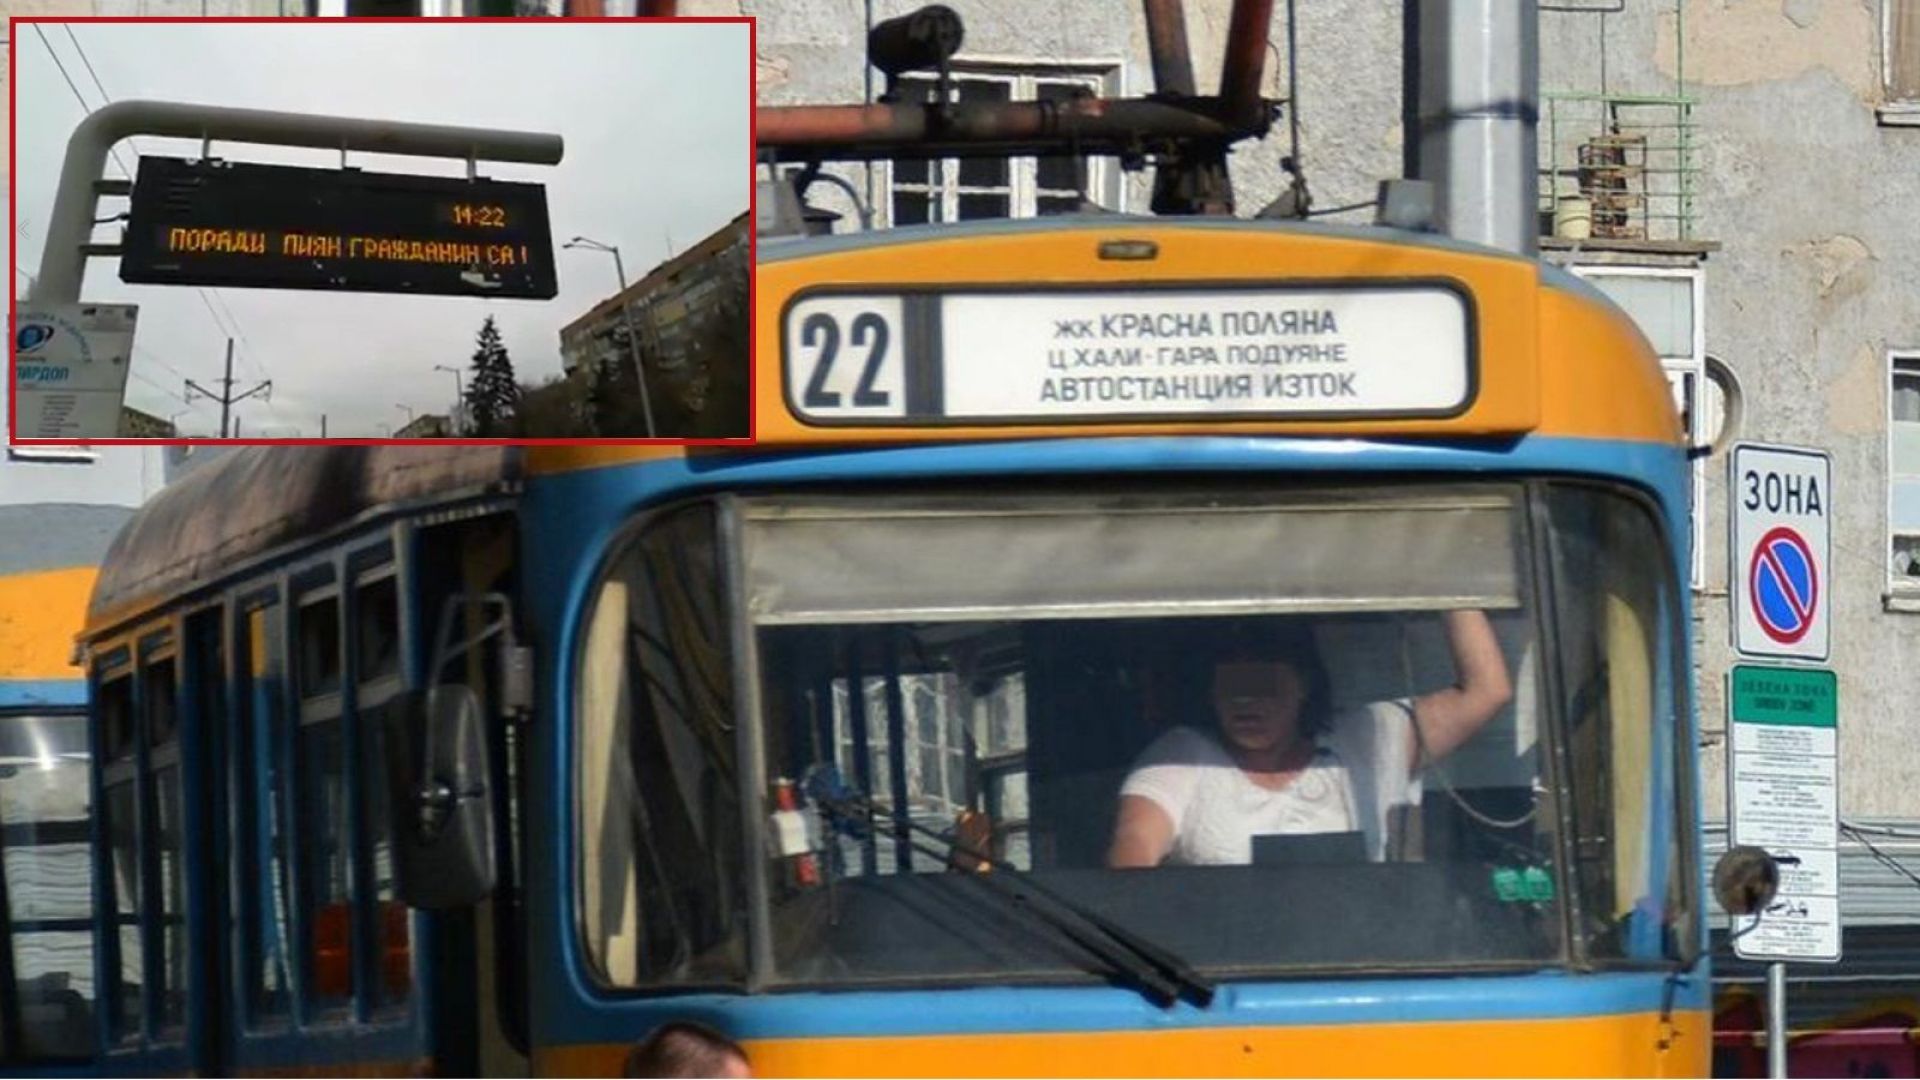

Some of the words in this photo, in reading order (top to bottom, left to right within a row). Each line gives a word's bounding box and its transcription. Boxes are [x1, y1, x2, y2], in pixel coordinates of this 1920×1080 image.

[453, 204, 505, 228] 14:22
[170, 227, 266, 255] ПОРАДИ
[283, 233, 342, 258] ПИЯН
[349, 236, 480, 265] ГРАЖДАНИН
[486, 245, 515, 265] СА
[1100, 311, 1214, 338] КРАСНА
[1221, 309, 1338, 337] ПОЛЯНА
[801, 311, 890, 408] 22
[1226, 342, 1348, 366] ПОДУЯНЕ
[1041, 375, 1253, 402] АВТОСТАНЦИЯ
[1264, 372, 1358, 399] ИЗТОК
[1744, 469, 1823, 517] ЗОНА
